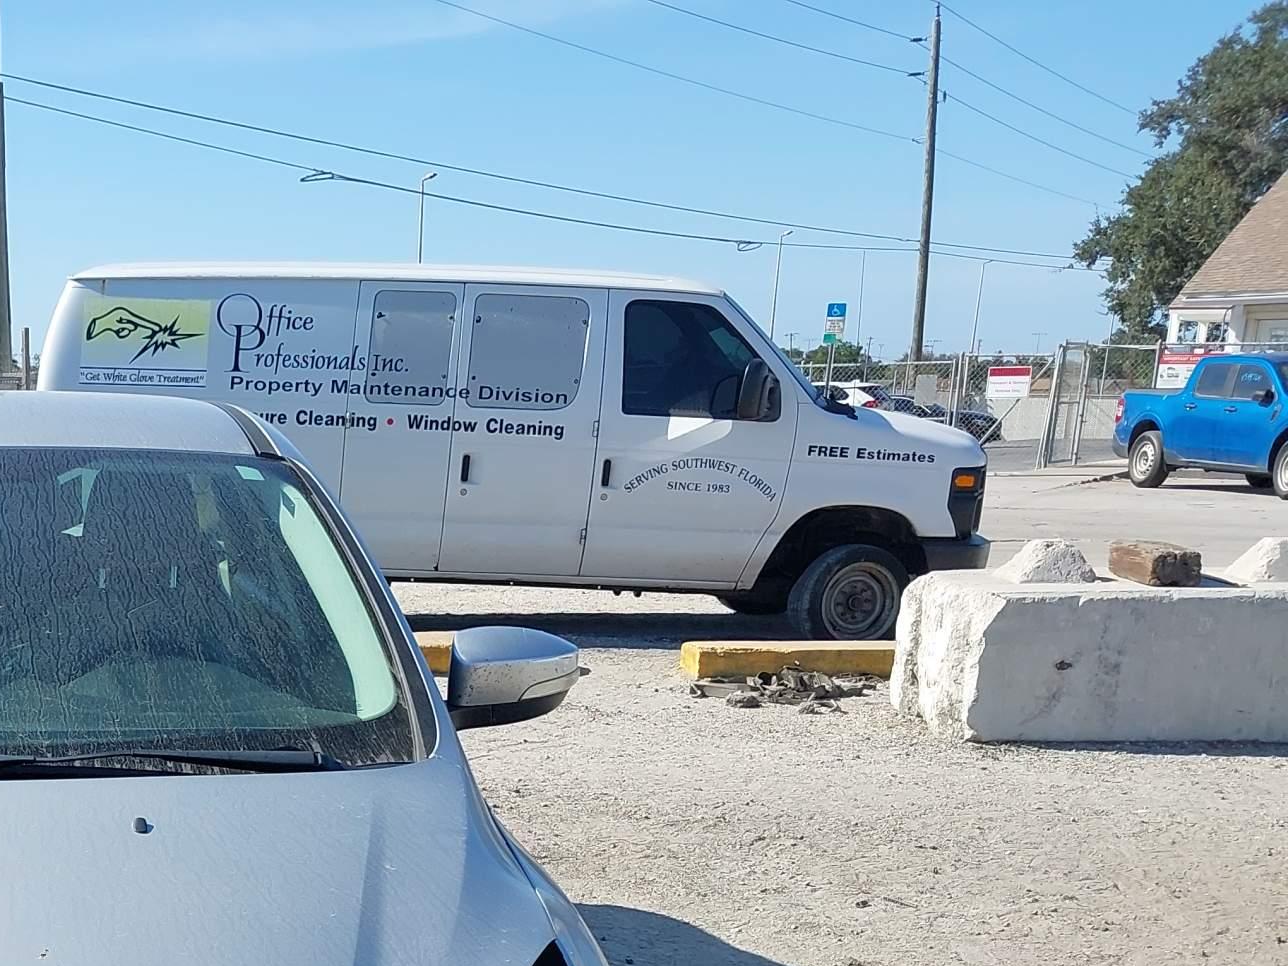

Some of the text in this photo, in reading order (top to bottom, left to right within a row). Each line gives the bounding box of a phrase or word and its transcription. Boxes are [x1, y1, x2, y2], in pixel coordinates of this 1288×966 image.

[217, 293, 314, 337] Office
[224, 324, 409, 375] Professionals Inc.
[103, 368, 127, 382] White
[129, 370, 154, 383] Glove
[230, 376, 568, 404] Property Maintenance Division
[295, 410, 377, 431] Cleaning
[407, 414, 478, 432] Window
[486, 418, 564, 440] Cleaning
[807, 445, 936, 464] FREE Estimates
[623, 458, 777, 502] SERVING SOUTHWEST FLORIDA
[667, 481, 730, 494] SINCE 1983
